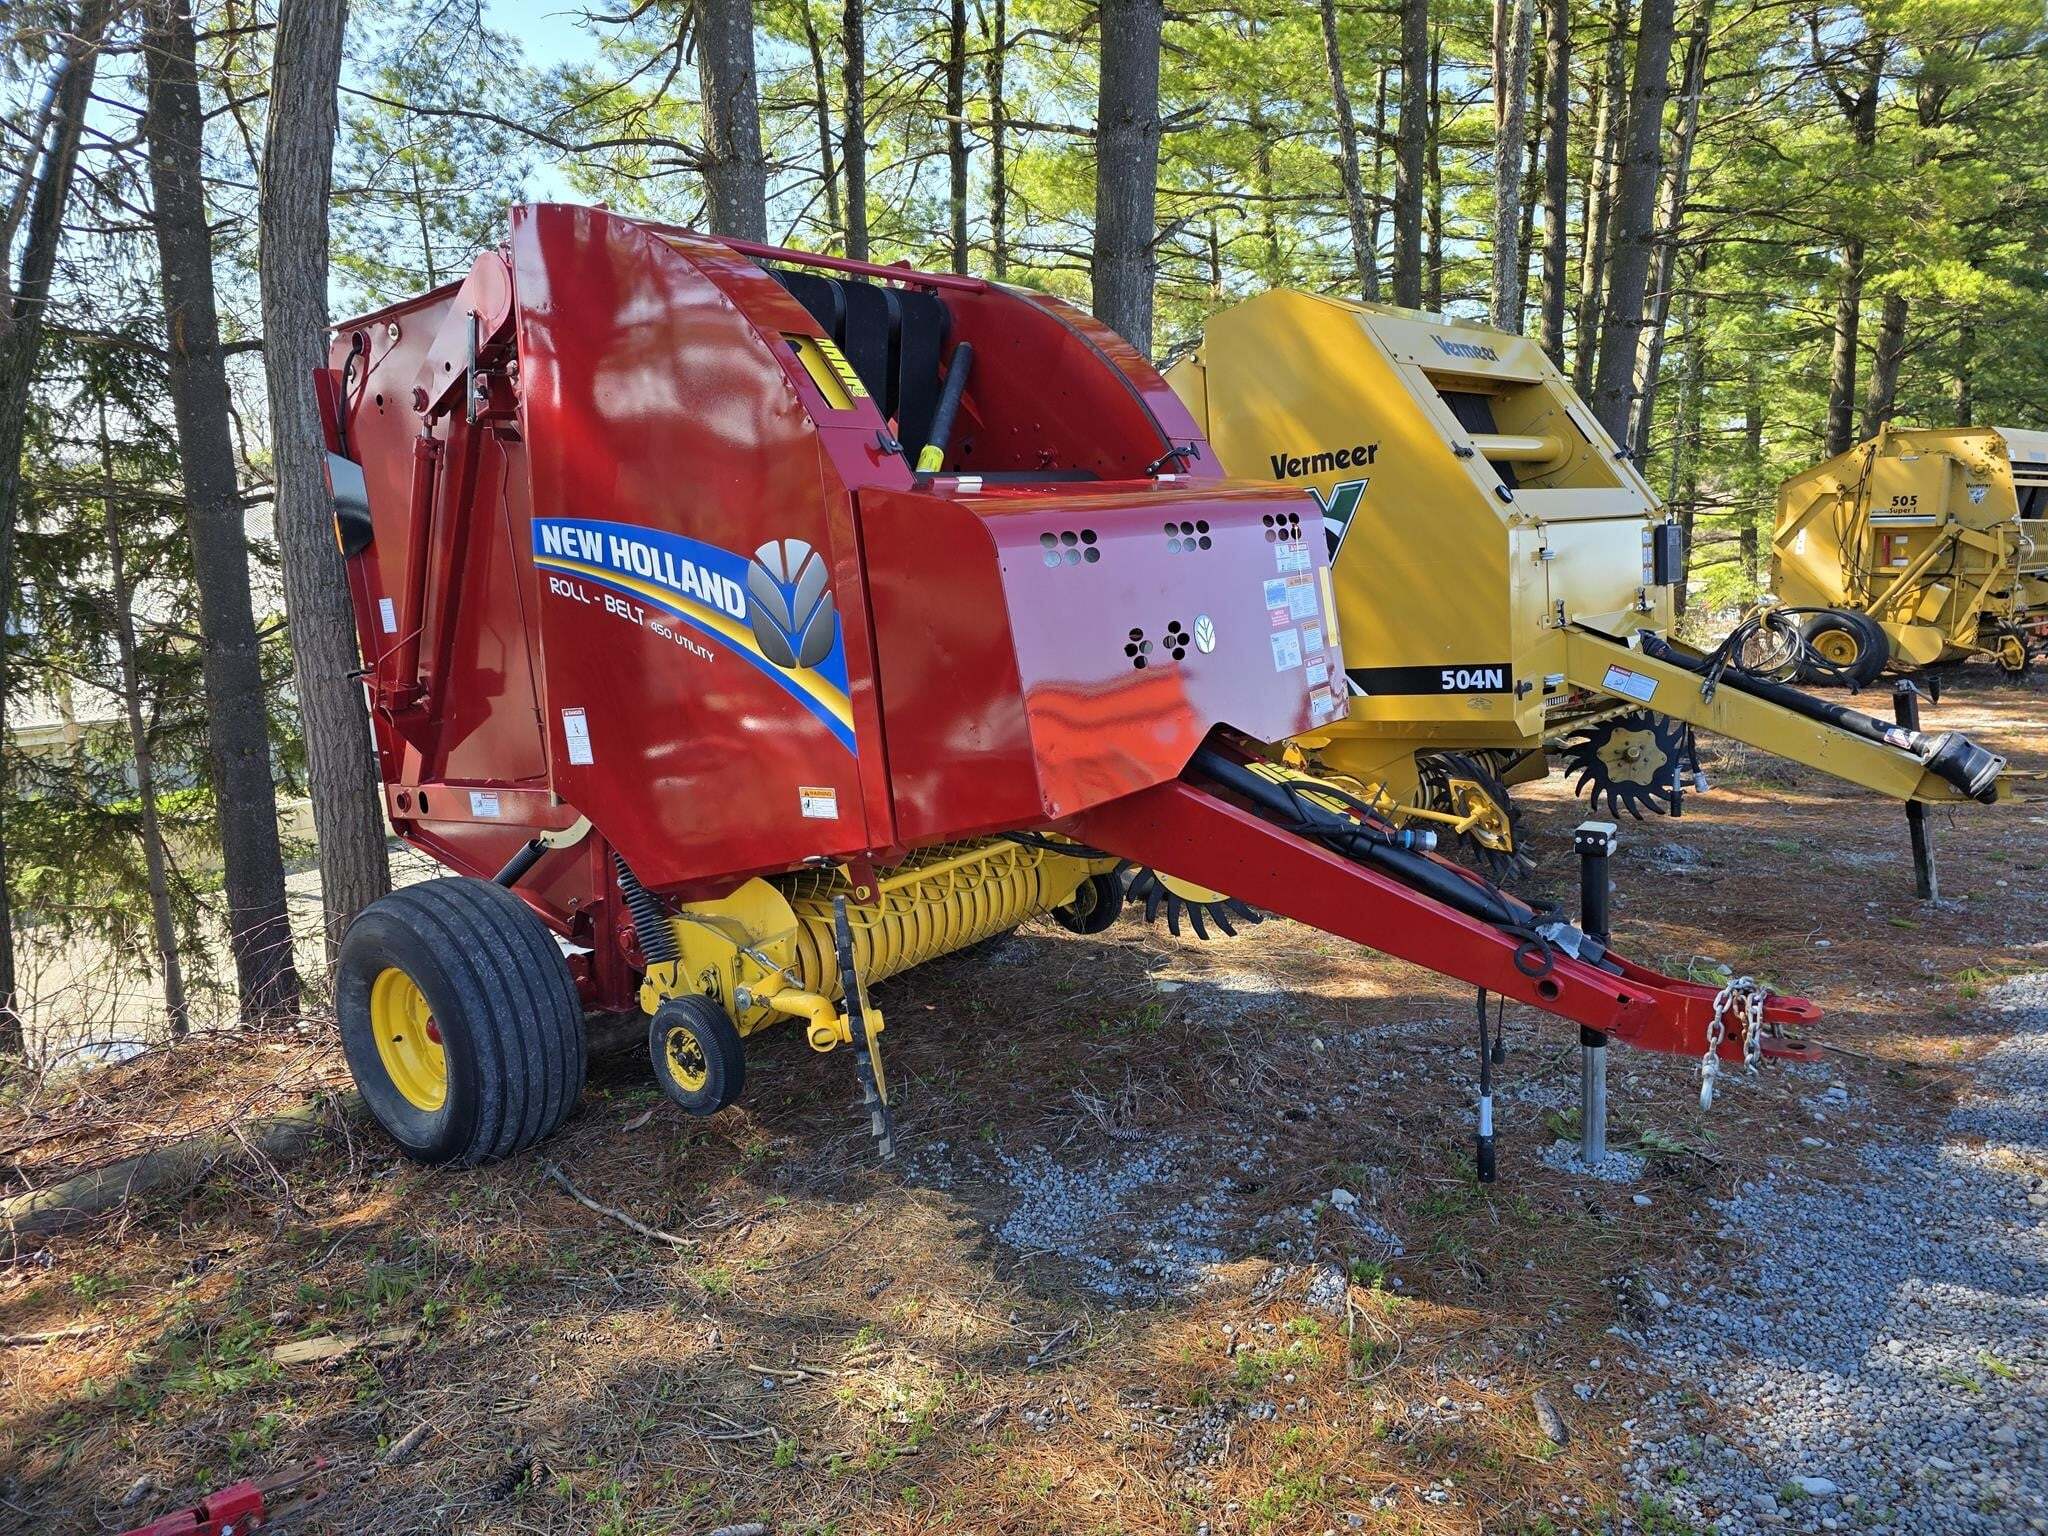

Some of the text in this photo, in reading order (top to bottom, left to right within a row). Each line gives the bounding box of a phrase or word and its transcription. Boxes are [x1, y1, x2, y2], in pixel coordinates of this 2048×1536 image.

[1430, 334, 1500, 362] Vermeer
[1270, 442, 1379, 480] Vermeer
[1891, 495, 1918, 507] 505
[541, 524, 747, 620] NEW HOLLAND
[549, 577, 590, 604] ROLL
[604, 594, 645, 626] BELT
[650, 621, 715, 662] 450 UTILITY
[1441, 669, 1503, 690] 504N
